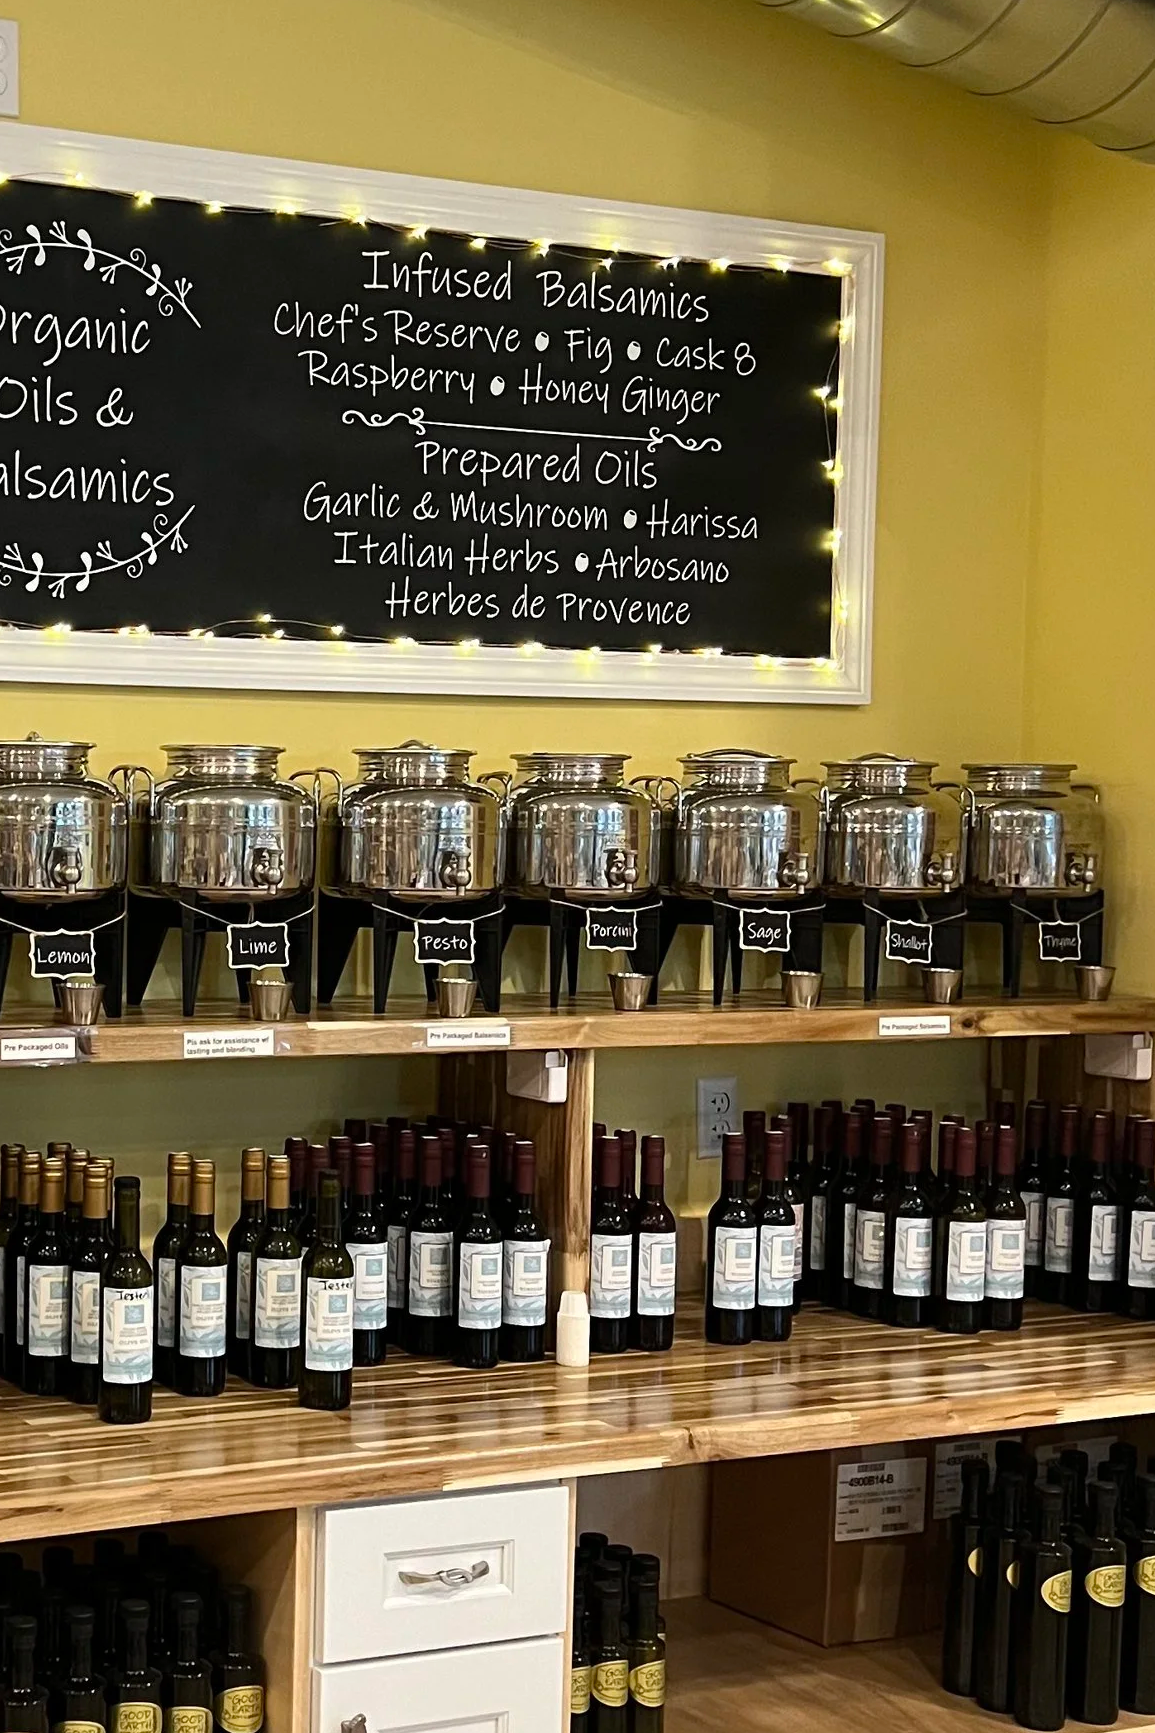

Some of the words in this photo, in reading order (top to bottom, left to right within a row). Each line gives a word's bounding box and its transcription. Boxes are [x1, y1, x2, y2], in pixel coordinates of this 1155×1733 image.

[361, 250, 512, 301] Infused
[535, 270, 709, 323] Balsamics
[273, 301, 378, 344] Chef's
[383, 309, 521, 353] Reserve
[563, 326, 613, 374] Fig
[656, 337, 726, 371] Cask
[734, 342, 757, 376] 8
[297, 349, 475, 405] Raspberry
[518, 362, 609, 415] Honey
[622, 375, 721, 425] Ginger
[95, 387, 134, 428] &
[414, 440, 580, 488] Prepared
[595, 449, 658, 490] Oils
[303, 480, 401, 524] Garlic
[412, 491, 440, 521] &
[450, 490, 608, 531] Mushroom
[645, 498, 758, 539] Harissa
[333, 531, 453, 571] Italian
[463, 532, 560, 576] Herbs
[595, 545, 730, 584] Arbosano
[384, 575, 500, 619] Herbes
[511, 583, 546, 619] de
[555, 592, 691, 625] Provence
[590, 923, 632, 938] Porcini
[747, 922, 782, 946] Sage
[891, 933, 928, 951] Shallot
[239, 938, 278, 955] Lime
[421, 935, 468, 951] Pesto
[37, 947, 90, 965] Lemon
[18, 1043, 53, 1051] Packaged
[443, 1032, 473, 1040] Packaged
[120, 1709, 152, 1721] GOOD
